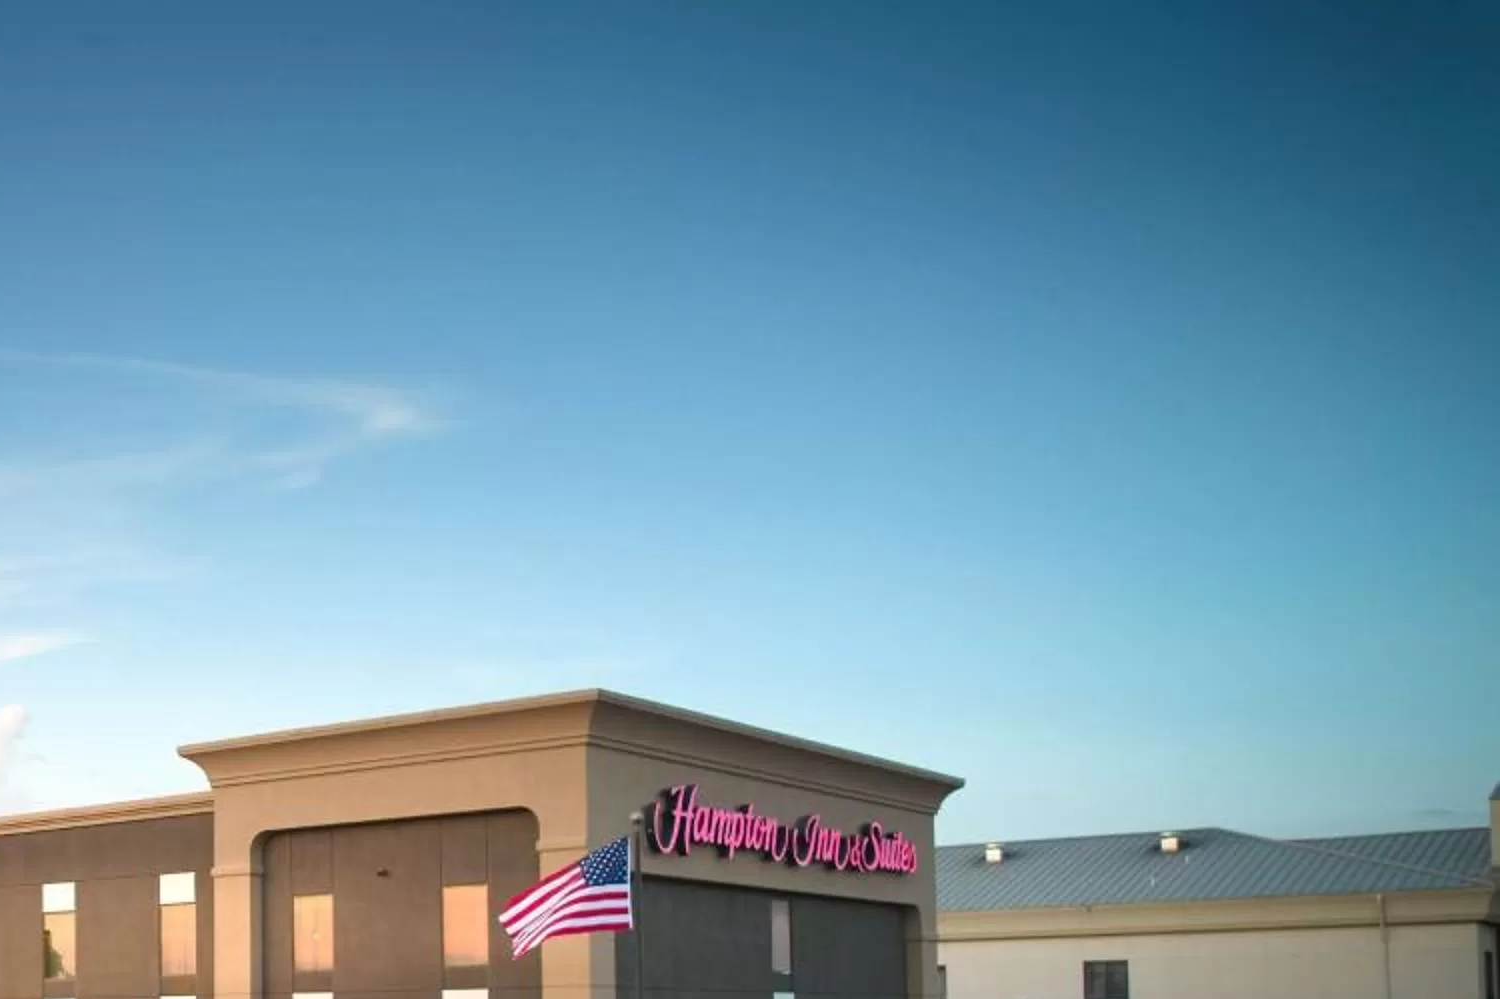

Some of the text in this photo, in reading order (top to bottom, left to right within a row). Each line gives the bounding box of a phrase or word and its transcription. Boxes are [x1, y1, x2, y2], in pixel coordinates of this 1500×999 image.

[653, 783, 917, 873] Hampton Inn & Suites
